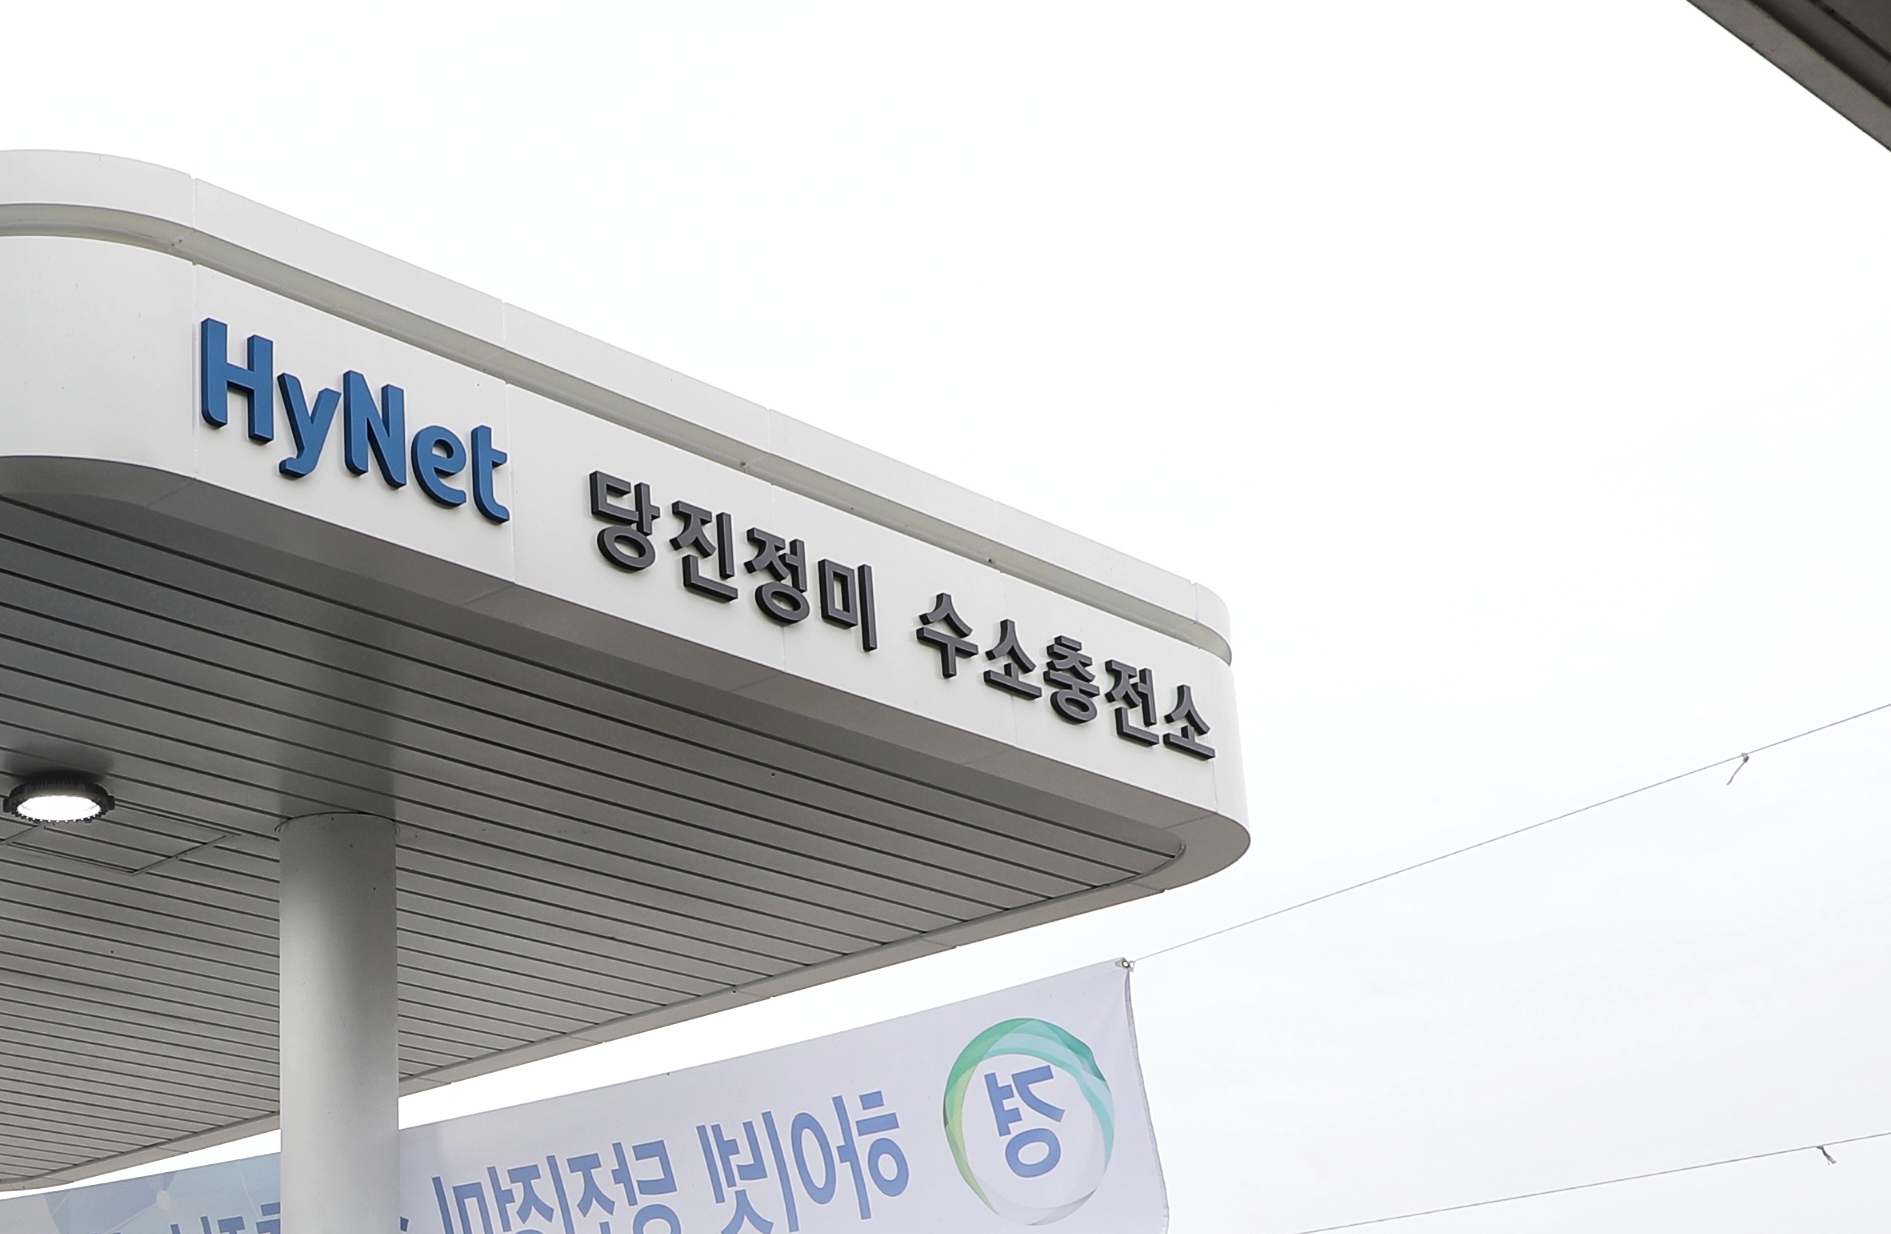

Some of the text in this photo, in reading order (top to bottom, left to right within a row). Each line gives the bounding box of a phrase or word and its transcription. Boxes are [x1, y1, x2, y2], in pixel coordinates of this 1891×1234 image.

[201, 317, 509, 523] HyNet
[588, 470, 1215, 760] 당진정미 수소충전소
